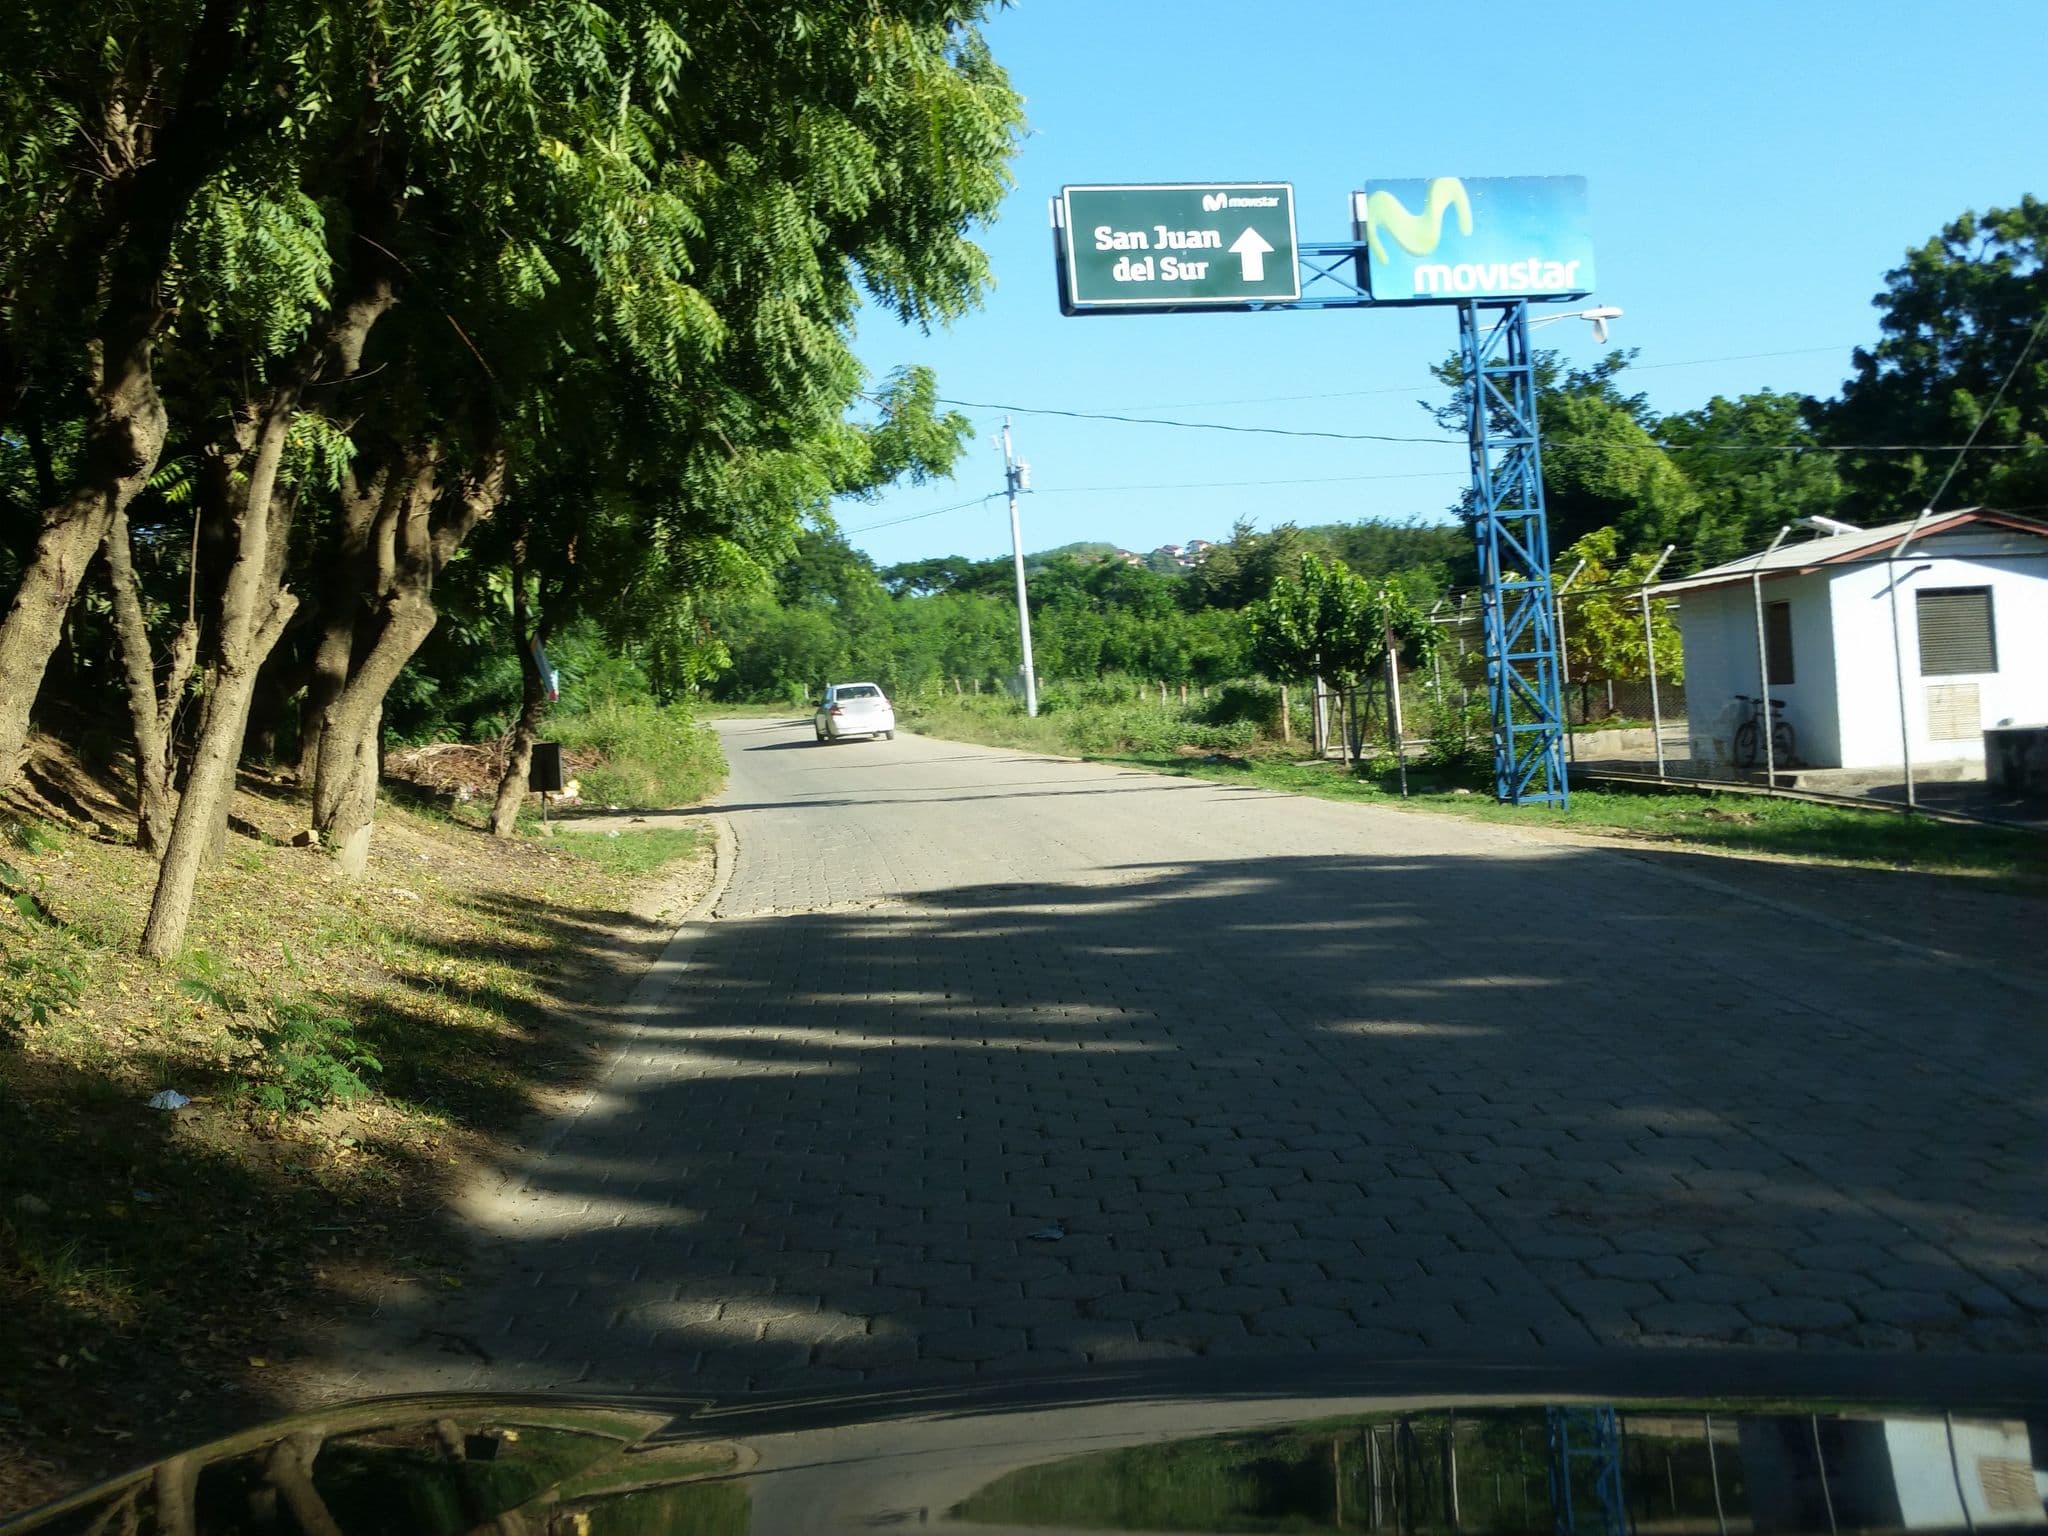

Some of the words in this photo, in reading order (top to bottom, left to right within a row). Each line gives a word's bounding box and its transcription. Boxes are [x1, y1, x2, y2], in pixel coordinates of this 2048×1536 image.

[1229, 196, 1279, 208] movistar
[1095, 226, 1149, 250] San
[1153, 226, 1222, 250] Juan
[1112, 257, 1154, 282] del
[1160, 257, 1209, 281] Sur
[1414, 258, 1580, 293] movistar
